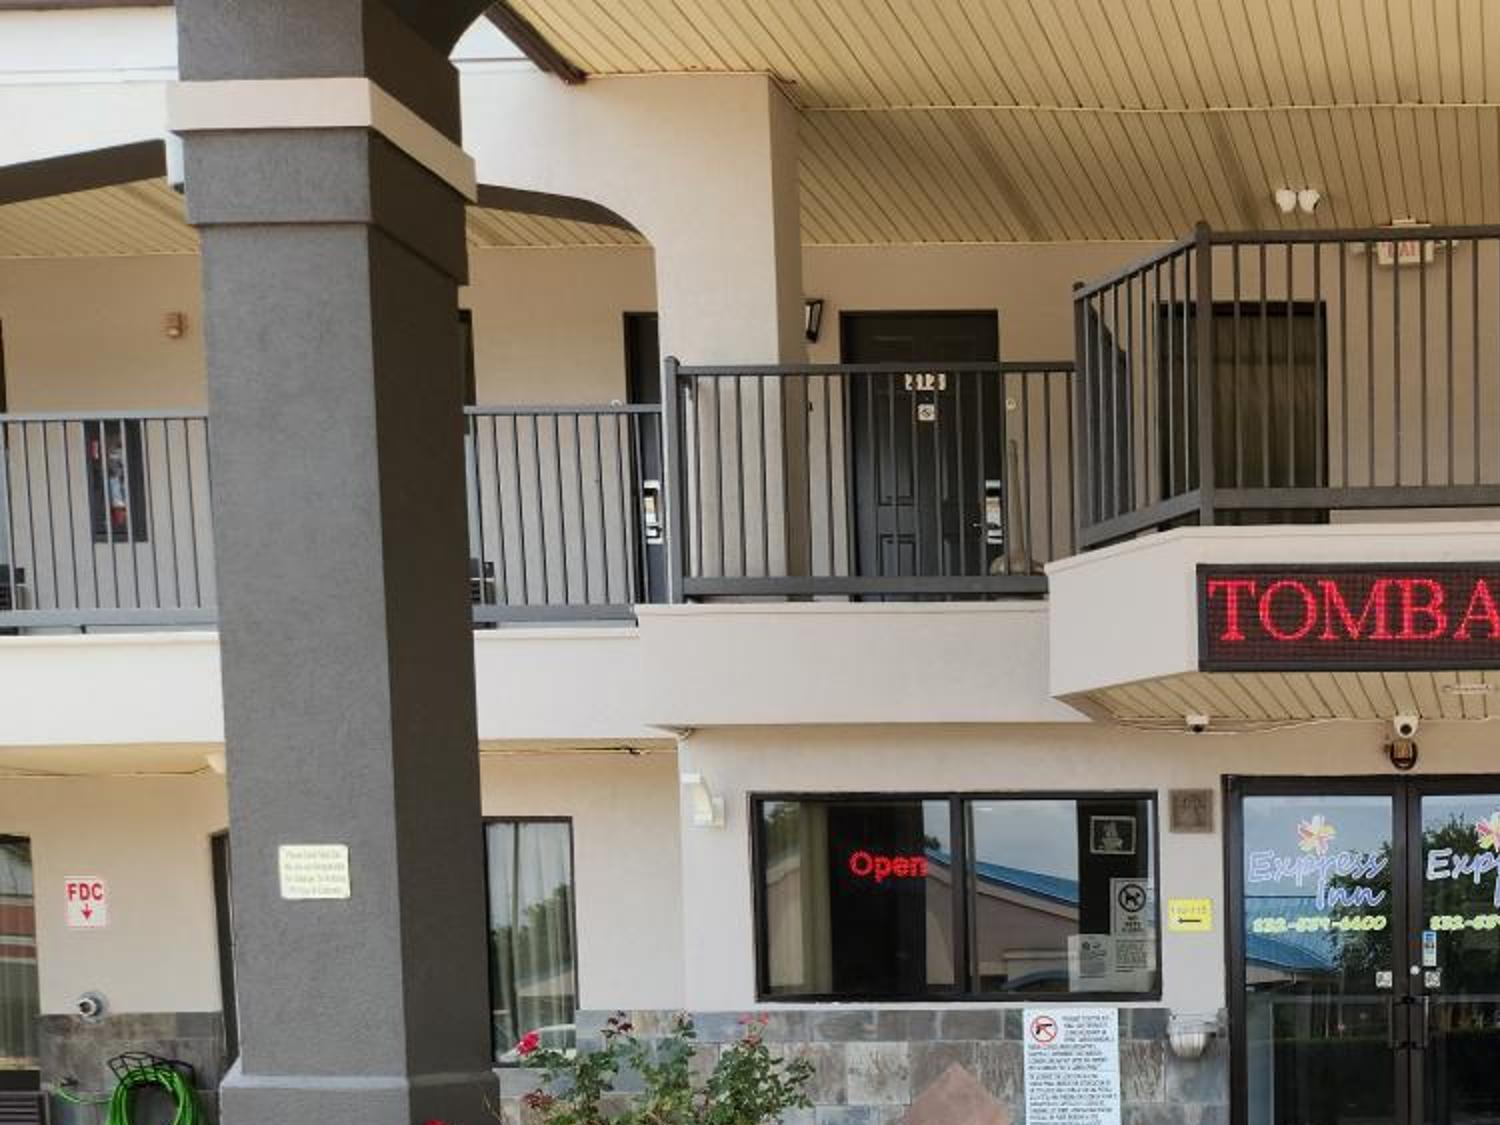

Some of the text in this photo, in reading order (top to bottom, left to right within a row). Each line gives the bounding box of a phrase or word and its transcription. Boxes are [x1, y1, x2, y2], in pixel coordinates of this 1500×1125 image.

[849, 851, 929, 882] Open
[1248, 850, 1388, 887] Express
[67, 882, 104, 901] FDC
[1314, 878, 1387, 909] Inn
